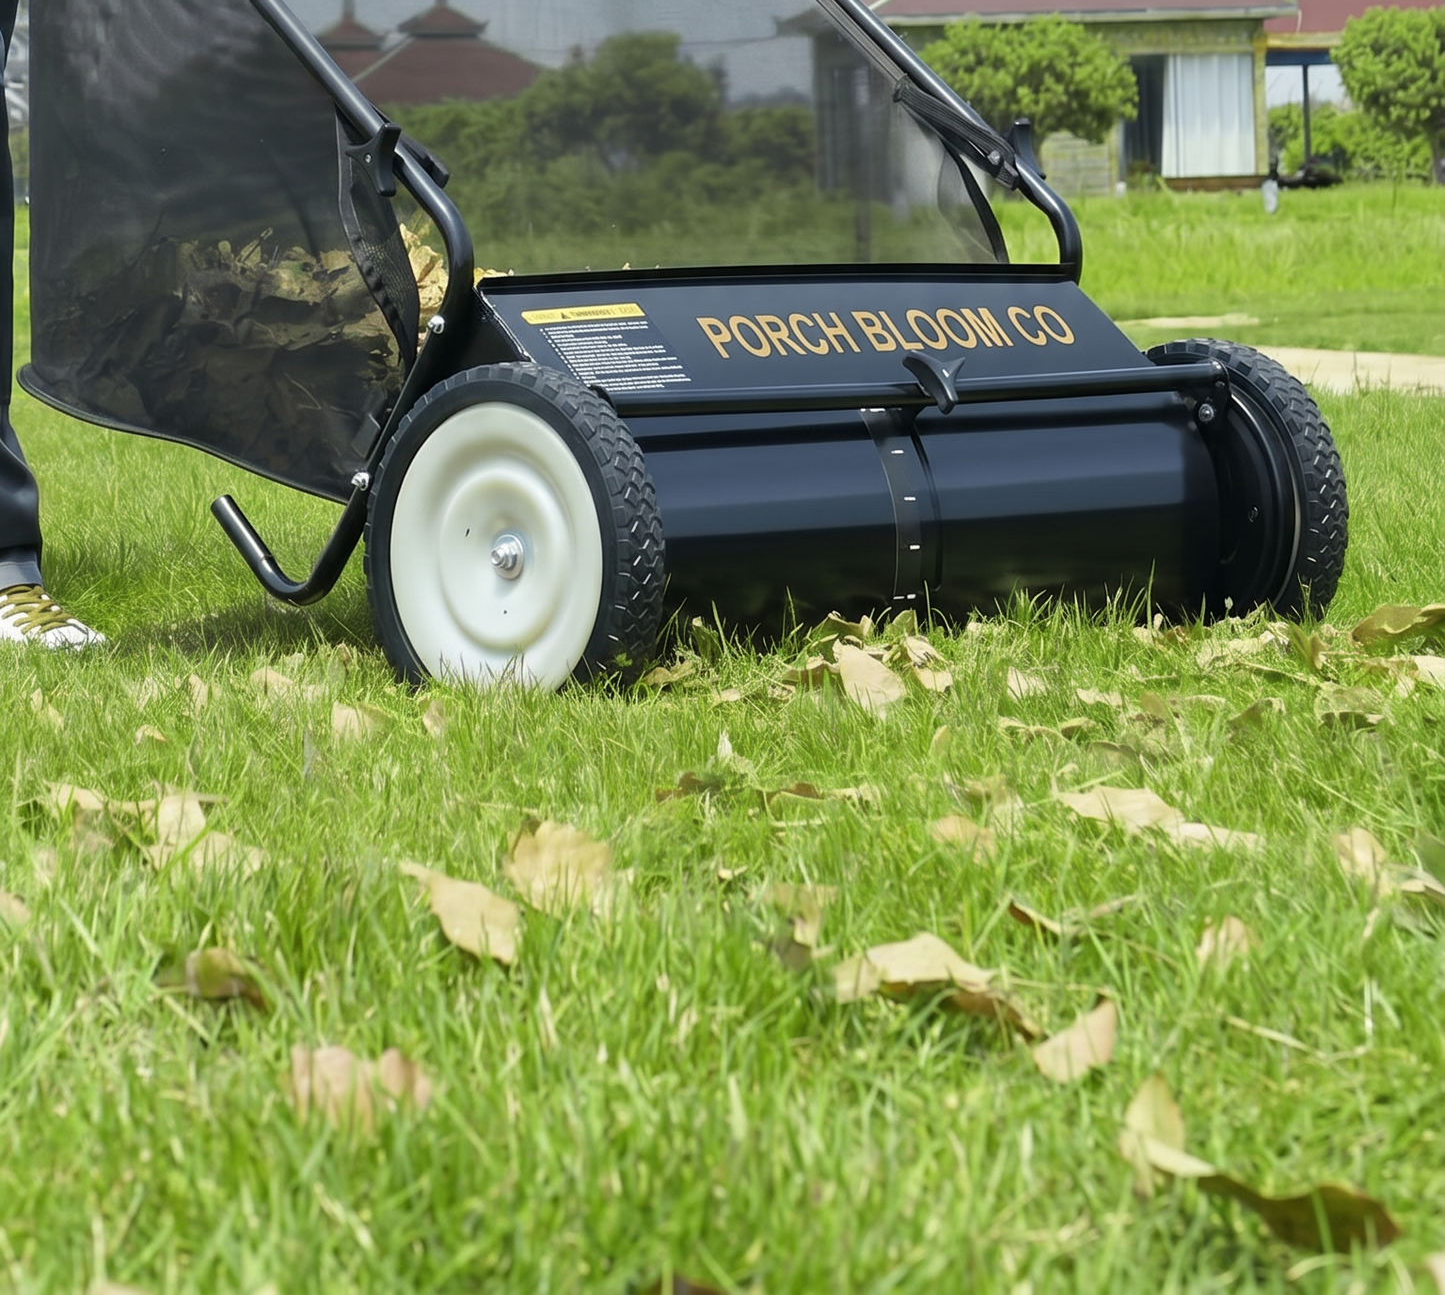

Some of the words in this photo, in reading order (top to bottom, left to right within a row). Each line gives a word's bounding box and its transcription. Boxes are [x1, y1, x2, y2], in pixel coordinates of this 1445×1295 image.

[696, 311, 861, 359] PORCH
[851, 307, 1014, 352] BLOOM
[1006, 305, 1075, 346] CO
